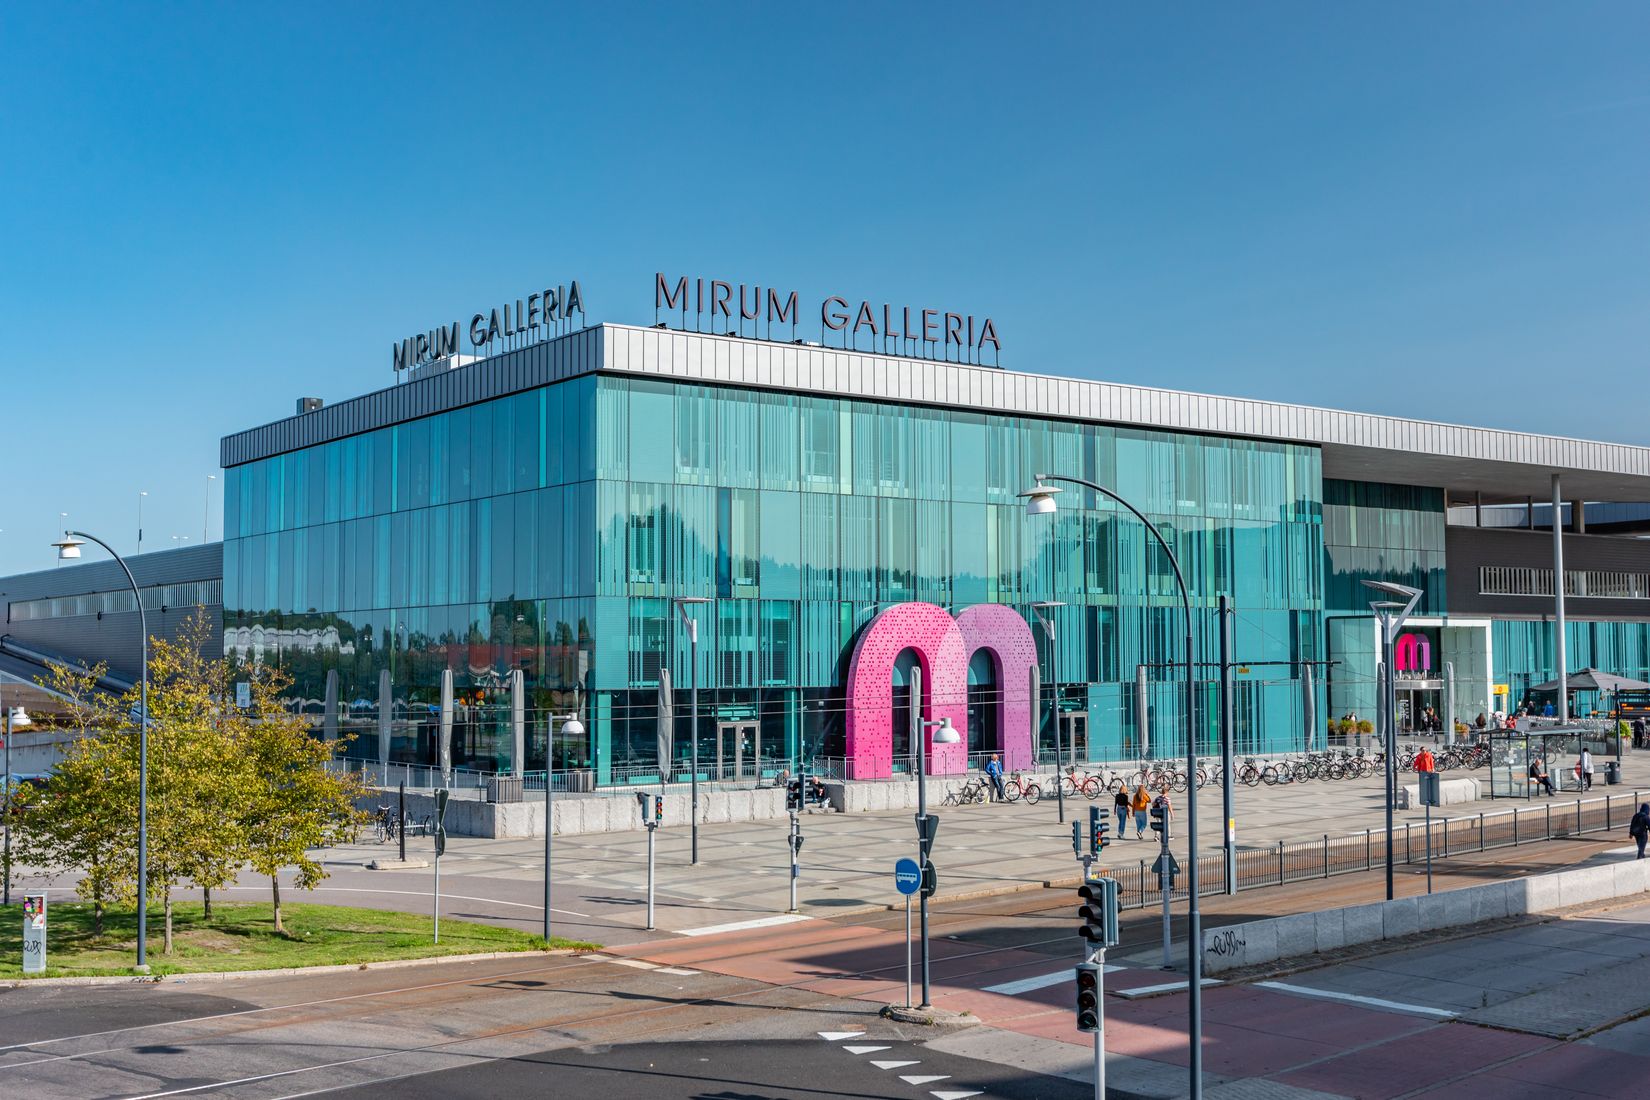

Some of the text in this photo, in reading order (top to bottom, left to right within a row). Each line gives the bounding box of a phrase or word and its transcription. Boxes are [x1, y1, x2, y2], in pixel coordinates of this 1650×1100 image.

[393, 280, 585, 372] MIRUM GALLERIA
[655, 272, 1001, 350] MIRUM GALLERIA
